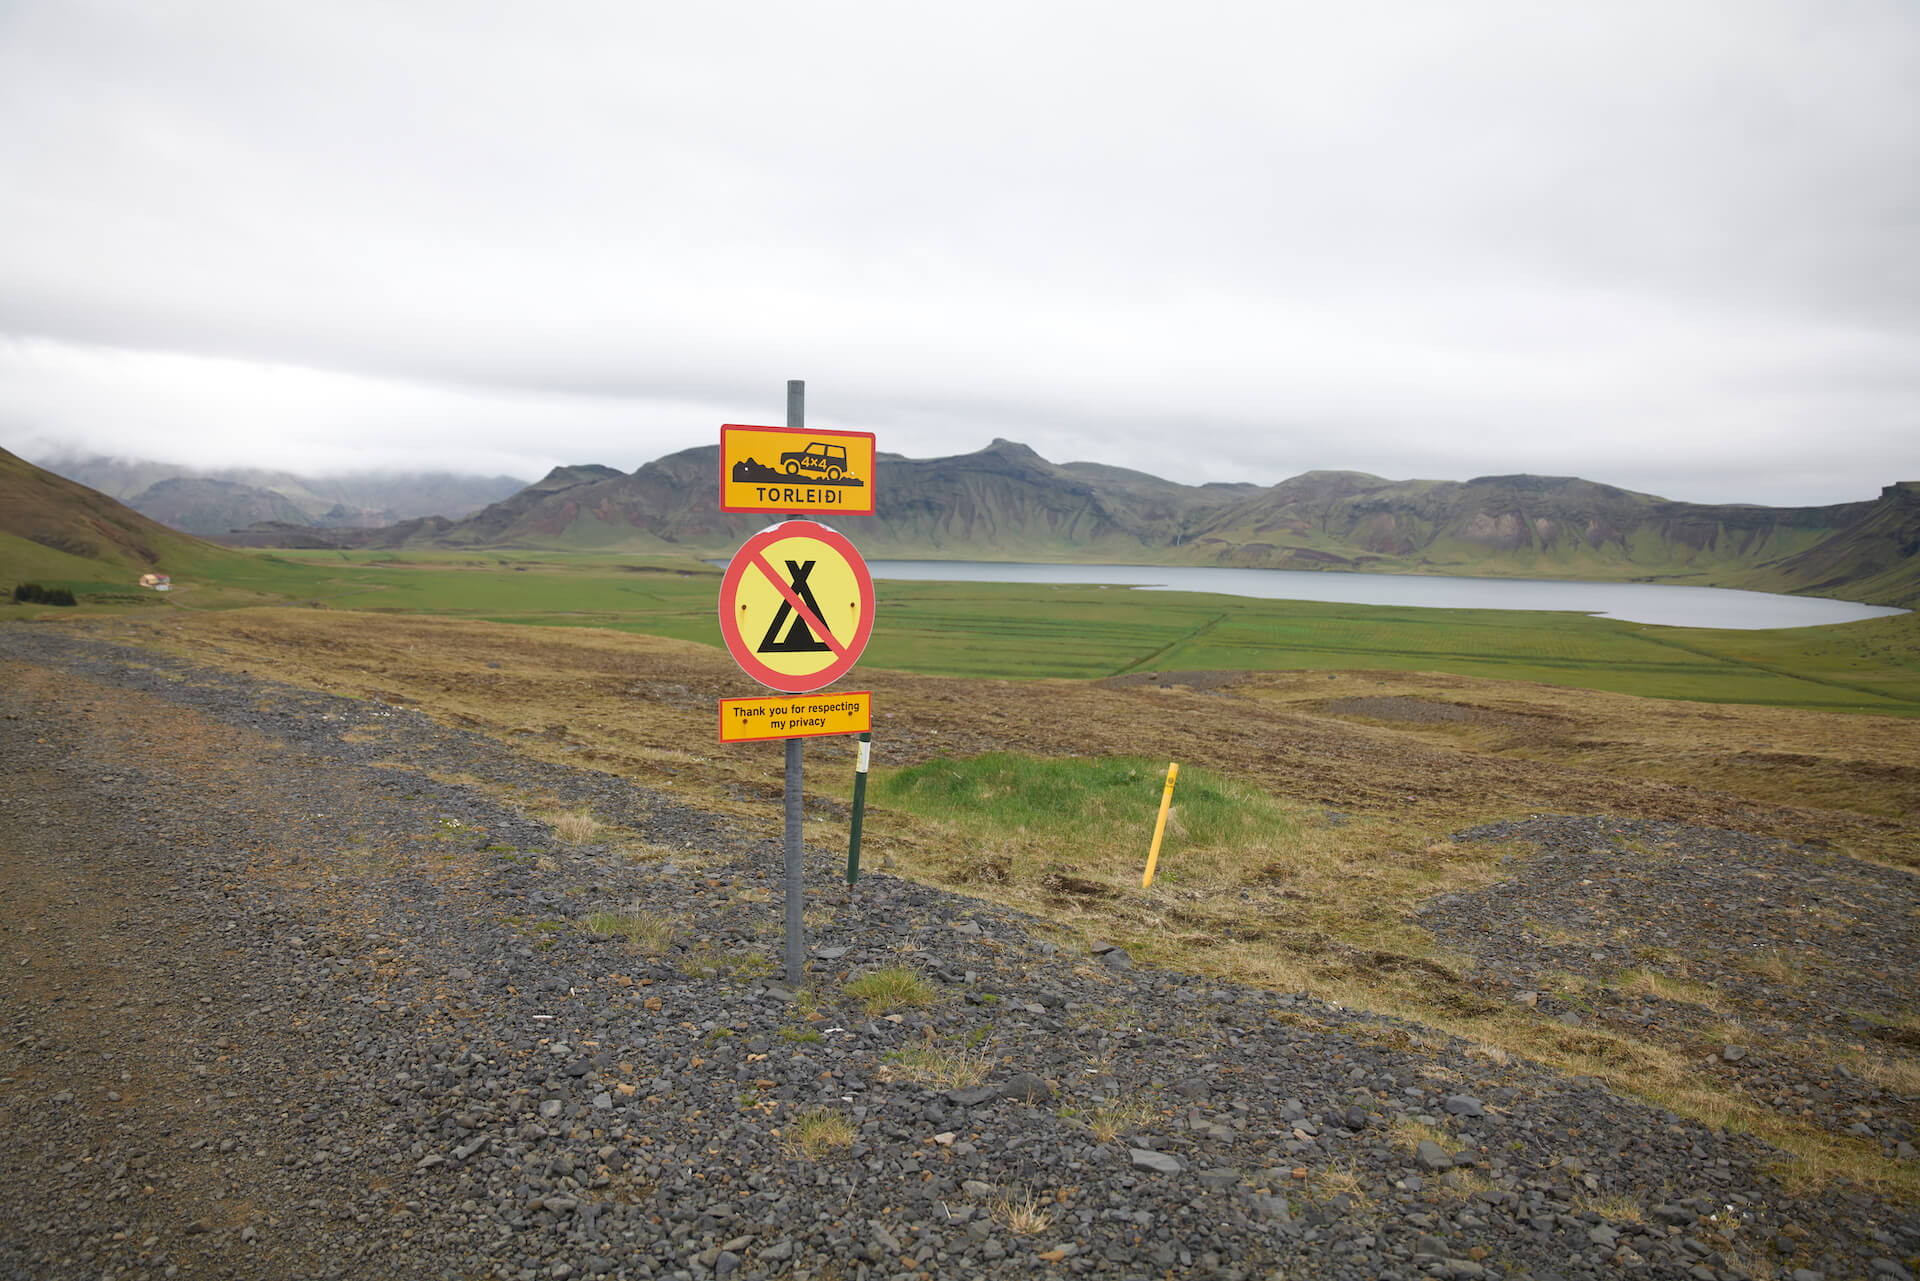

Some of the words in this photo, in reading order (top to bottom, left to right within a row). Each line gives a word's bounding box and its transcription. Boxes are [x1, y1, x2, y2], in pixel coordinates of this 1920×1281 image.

[801, 456, 827, 469] 4x4
[756, 487, 842, 504] TORLEIÐI
[733, 707, 766, 717] Thank
[769, 708, 788, 717] you
[791, 704, 805, 714] for
[808, 701, 860, 713] respecting
[770, 721, 786, 730] my
[789, 717, 826, 728] privacy
